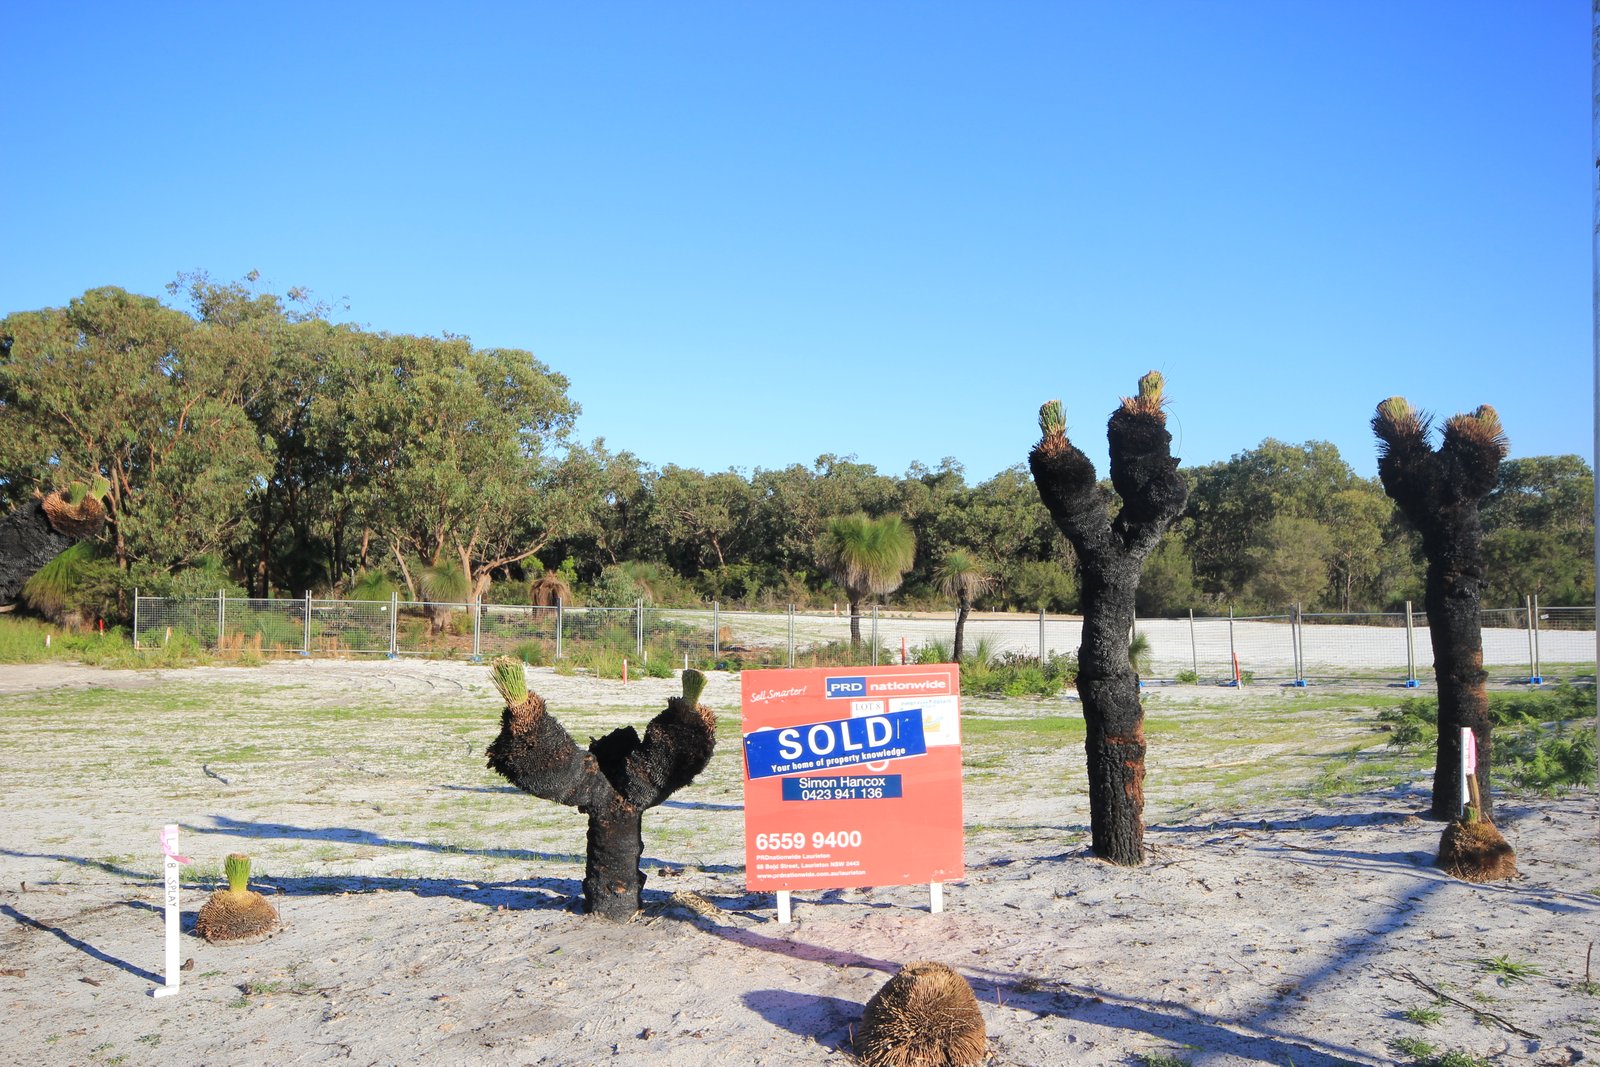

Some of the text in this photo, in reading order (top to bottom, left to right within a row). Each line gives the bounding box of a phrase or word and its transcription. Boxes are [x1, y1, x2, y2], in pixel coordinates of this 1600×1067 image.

[831, 680, 946, 692] PRD nationwide
[750, 685, 807, 702] Sell Smarter!
[855, 703, 872, 712] LOT
[778, 716, 893, 760] SOLD
[771, 760, 790, 773] Your
[792, 756, 814, 770] home
[816, 755, 824, 767] of
[826, 752, 860, 768] property
[862, 747, 906, 763] knowledge
[798, 776, 886, 788] Simon Hancox
[802, 788, 883, 800] 0423 941 136
[756, 830, 862, 850] 6559 9400
